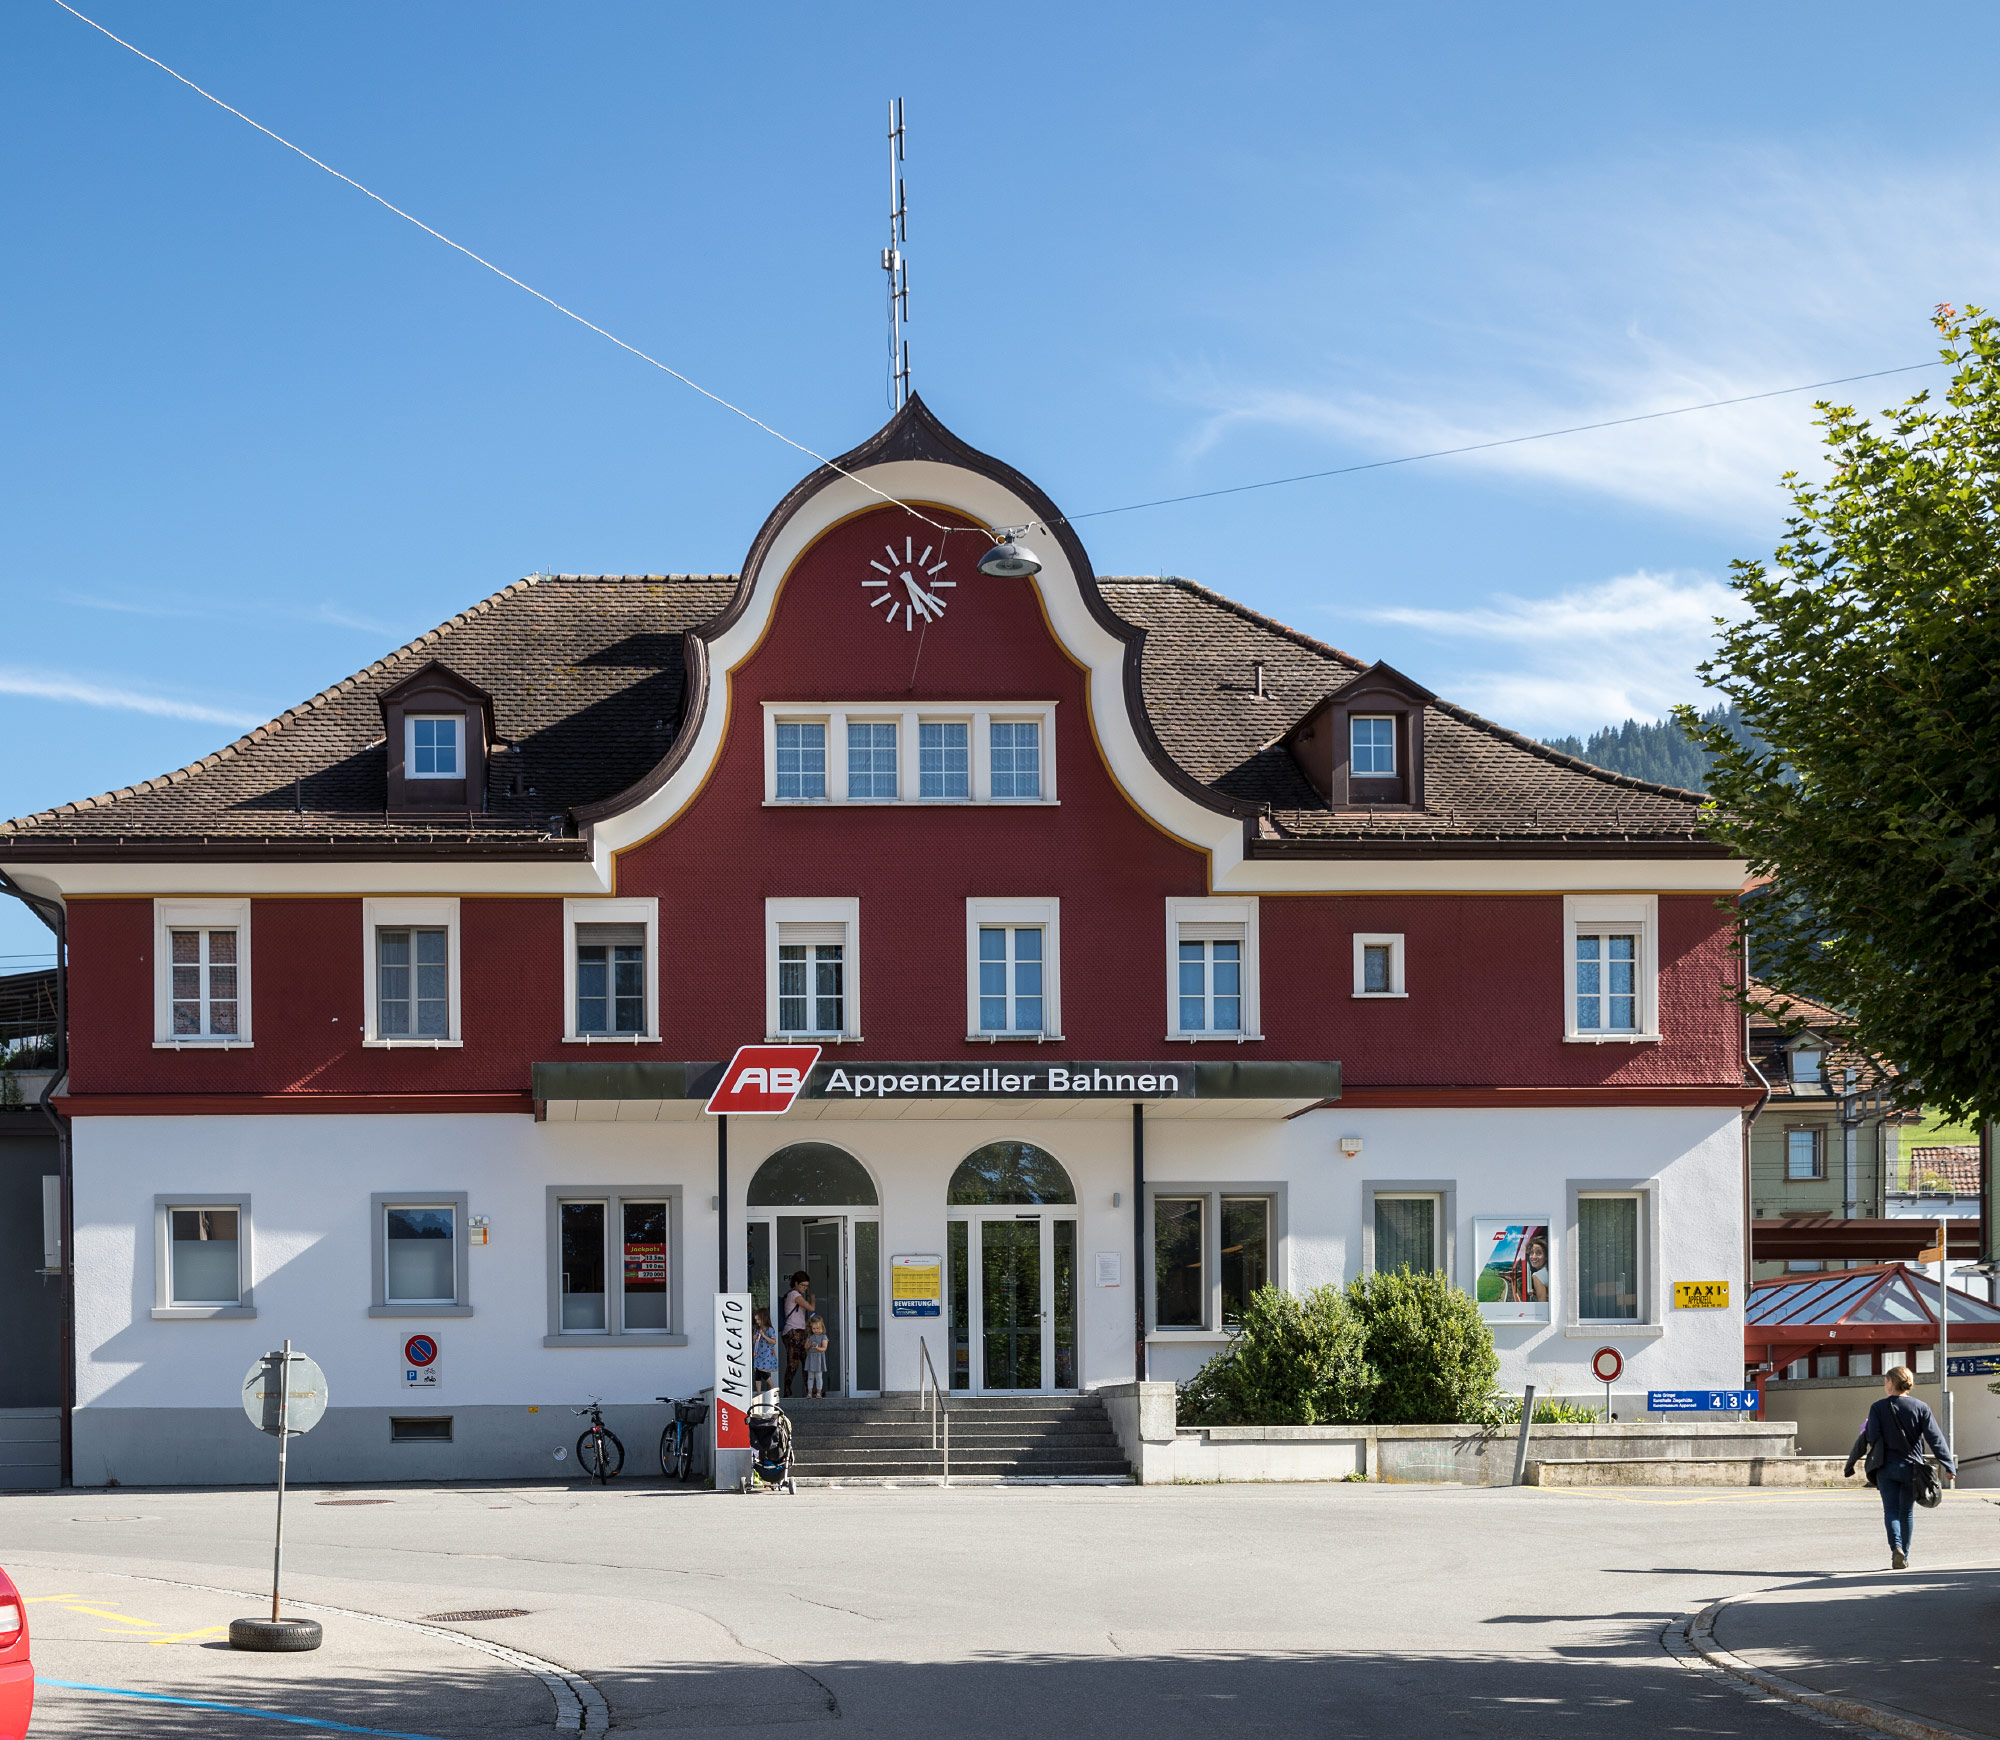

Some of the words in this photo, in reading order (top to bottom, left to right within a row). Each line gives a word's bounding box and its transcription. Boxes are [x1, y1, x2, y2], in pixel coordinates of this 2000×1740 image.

[731, 1067, 800, 1093] AB
[825, 1068, 1036, 1097] Appenzeller
[1049, 1068, 1179, 1092] Bahnen
[1683, 1286, 1720, 1296] TAXI
[1688, 1296, 1712, 1305] APPENZELL
[1960, 1363, 1966, 1373] 4
[1969, 1362, 1975, 1373] 3
[1713, 1397, 1721, 1407] 4
[1730, 1397, 1738, 1407] 3
